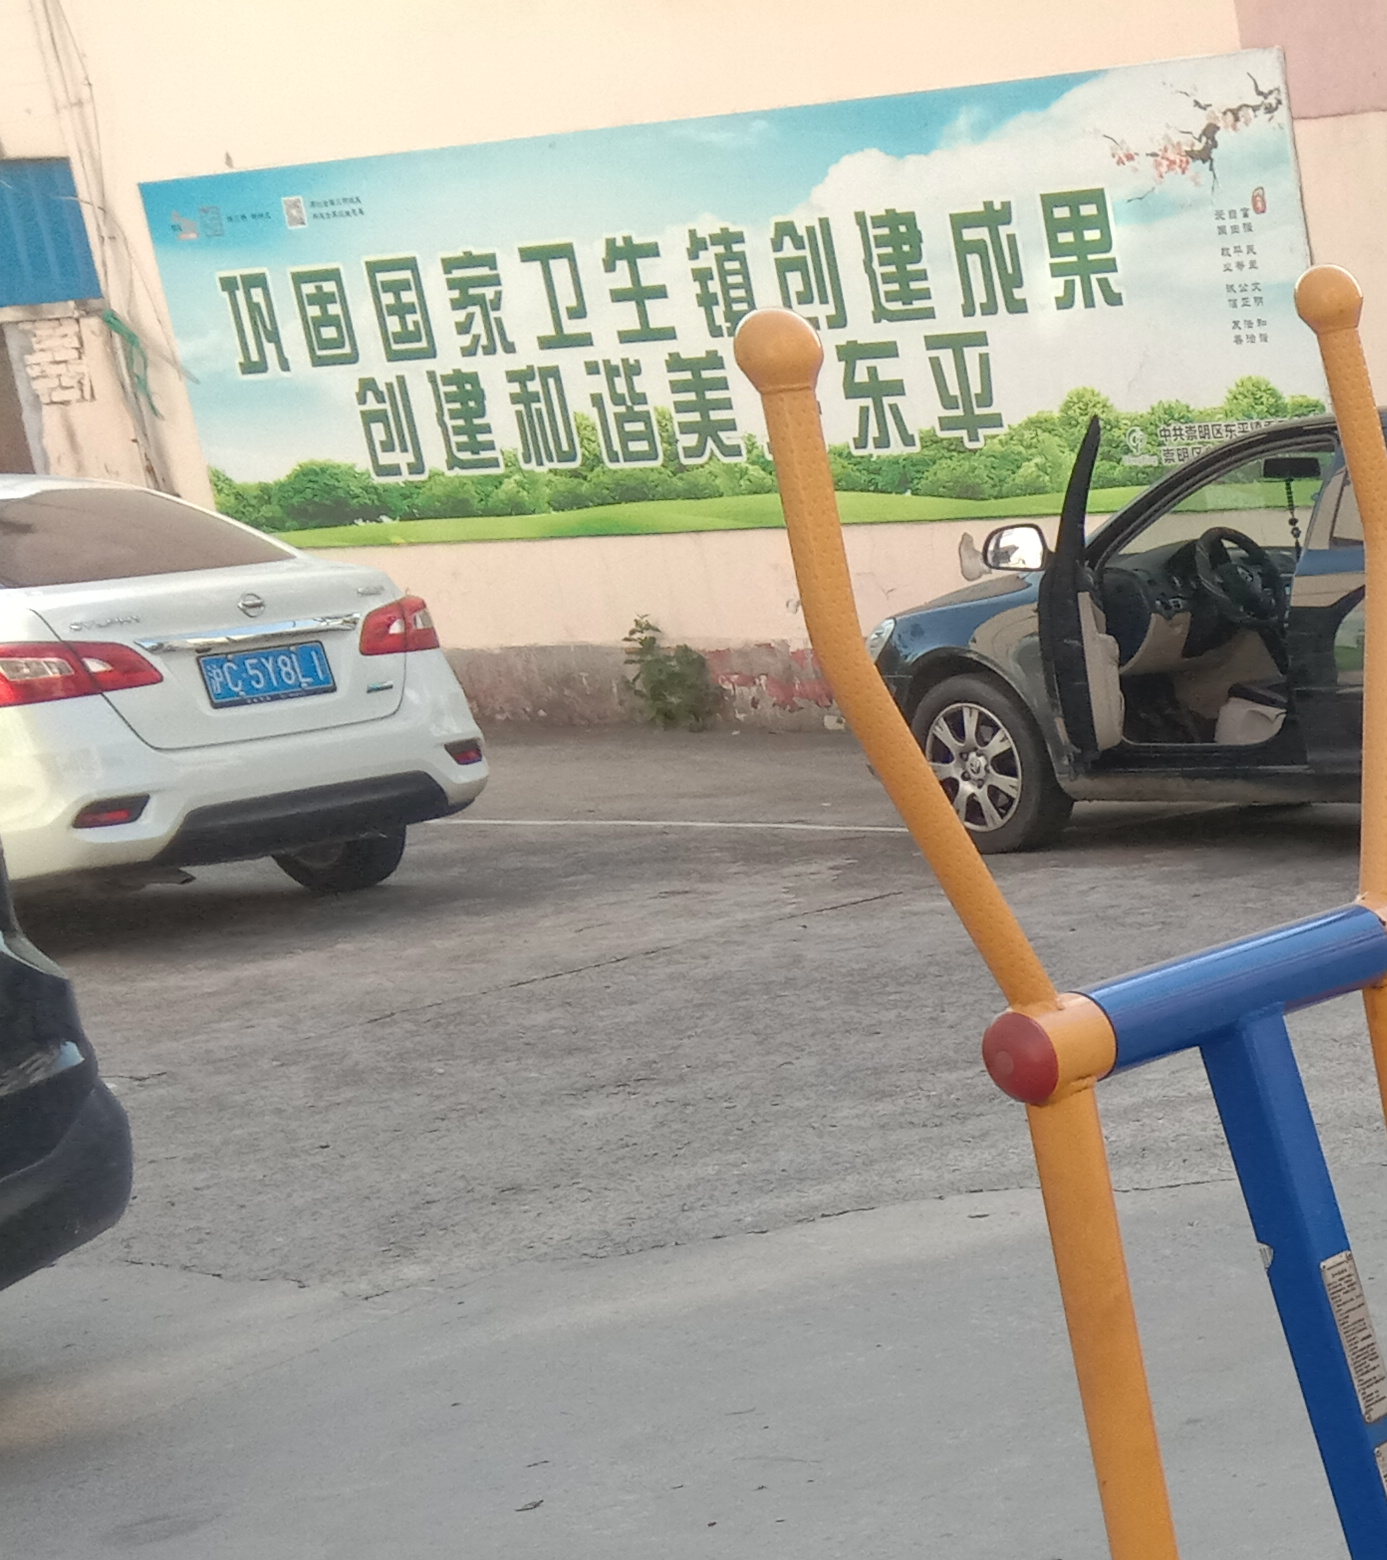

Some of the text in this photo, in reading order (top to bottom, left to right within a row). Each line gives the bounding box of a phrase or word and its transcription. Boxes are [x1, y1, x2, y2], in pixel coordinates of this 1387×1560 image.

[217, 188, 1124, 376] 巩固国家卫生镇创建成果
[356, 329, 1003, 478] 创建和谐美东平
